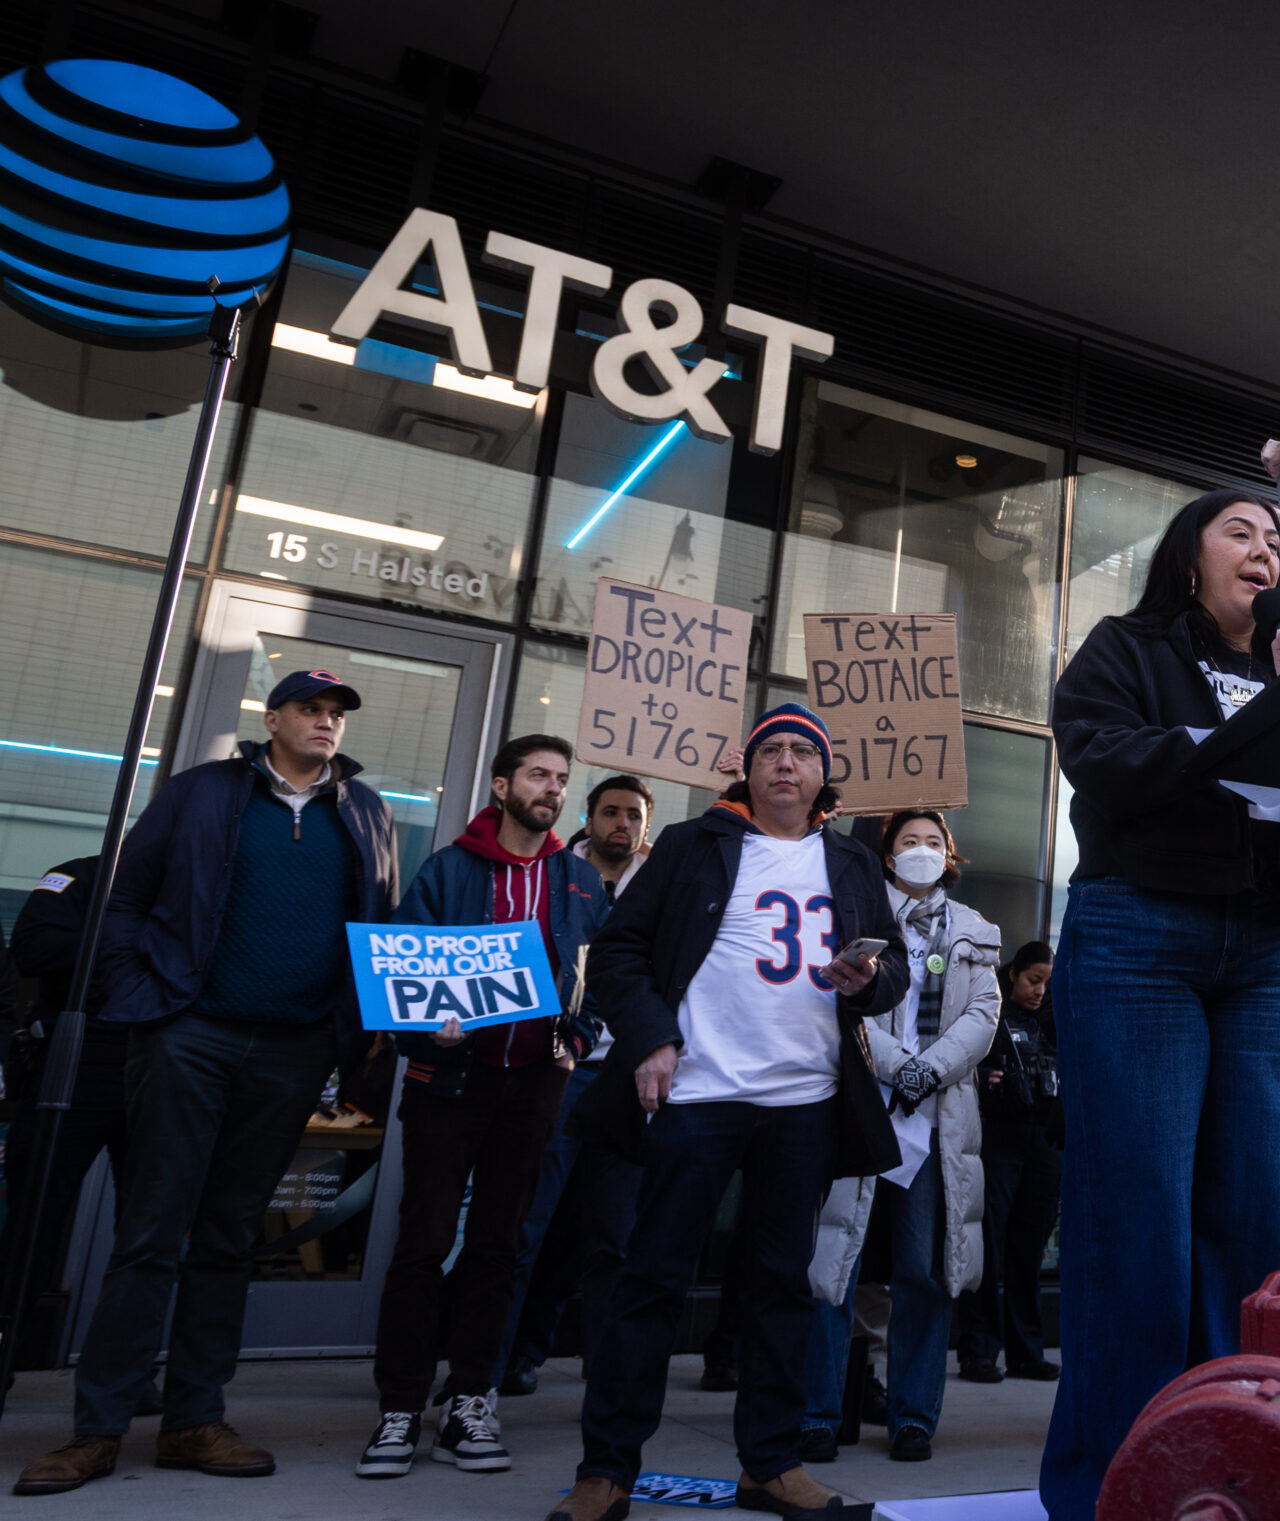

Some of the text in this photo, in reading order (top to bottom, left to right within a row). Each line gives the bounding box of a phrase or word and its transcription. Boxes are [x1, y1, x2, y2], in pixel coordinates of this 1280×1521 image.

[329, 207, 834, 456] AT&T
[267, 531, 488, 598] 15 S Halsted
[610, 585, 733, 653] Text
[820, 615, 932, 651] Text
[591, 634, 740, 703] DROPICE
[812, 656, 960, 708] BOTAICE
[641, 693, 678, 720] to
[876, 715, 895, 732] a
[590, 708, 728, 772] 51767
[829, 734, 948, 783] 51767
[369, 931, 523, 957] NO PROFIT
[370, 952, 516, 975] FROM OUR
[755, 889, 841, 992] 33
[391, 970, 534, 1020] PAIN
